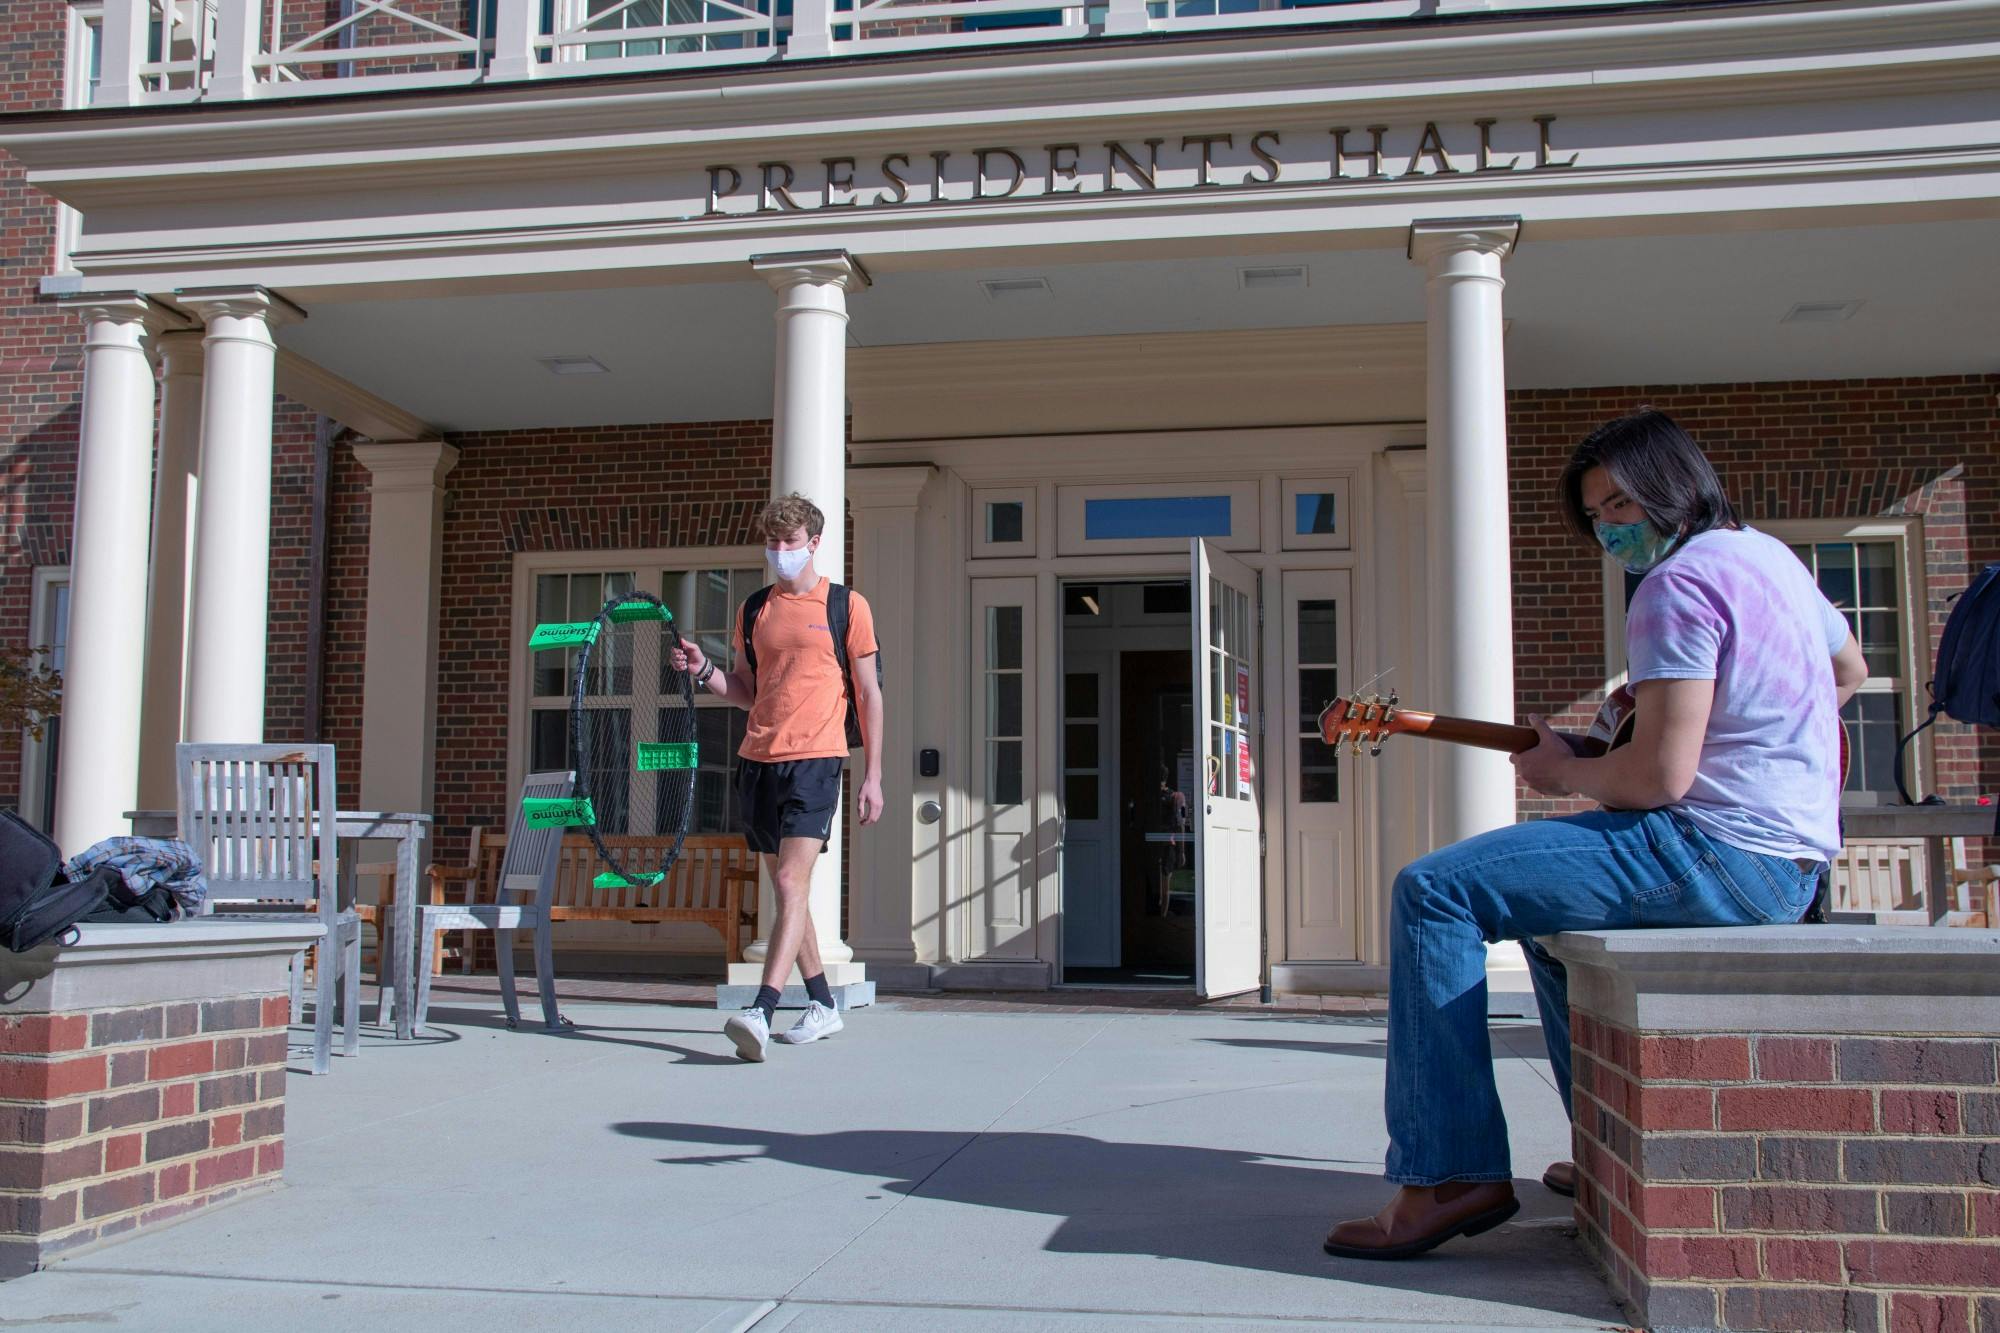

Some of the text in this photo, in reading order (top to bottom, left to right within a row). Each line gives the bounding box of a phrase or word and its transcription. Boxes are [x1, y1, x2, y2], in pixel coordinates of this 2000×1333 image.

[705, 114, 1580, 214] PRESIDENTS HALL
[539, 627, 588, 637] Slammo
[532, 808, 582, 820] Slammo
